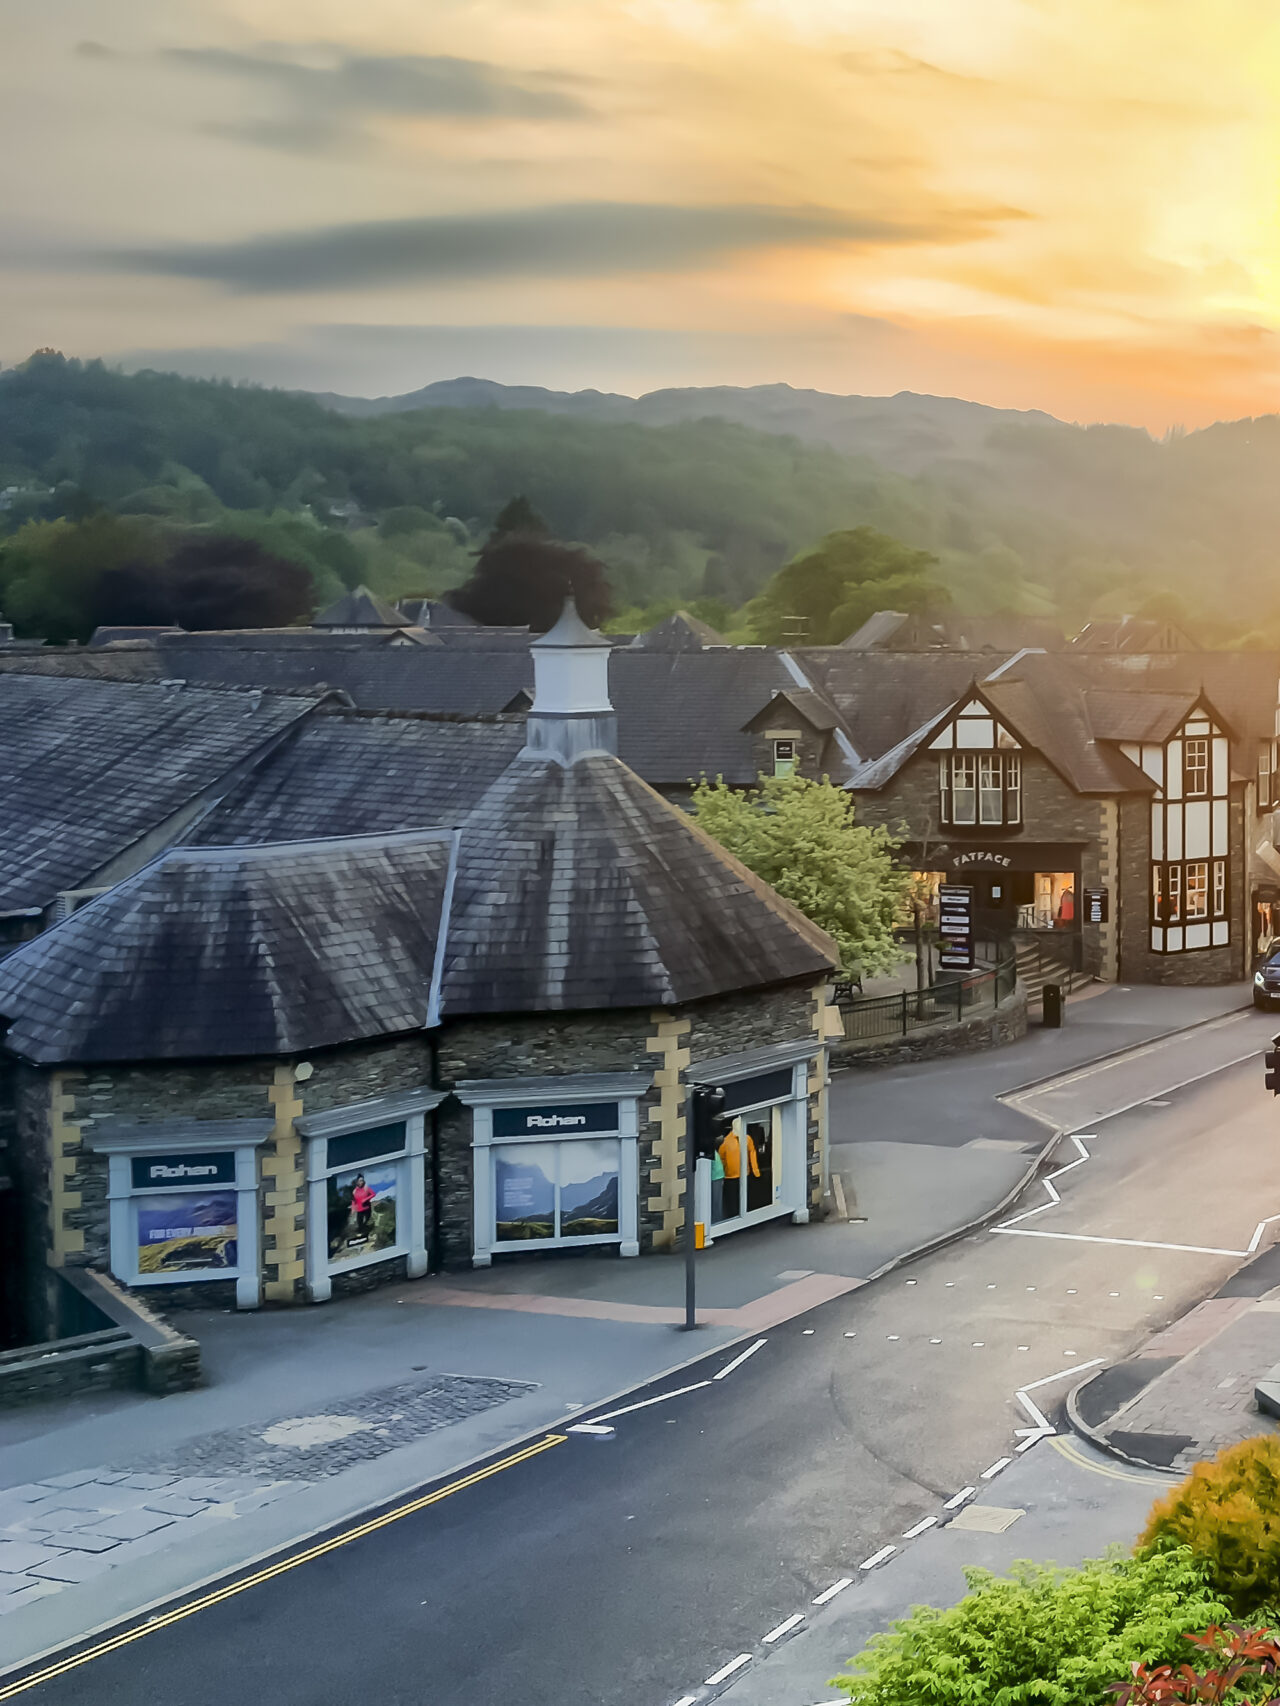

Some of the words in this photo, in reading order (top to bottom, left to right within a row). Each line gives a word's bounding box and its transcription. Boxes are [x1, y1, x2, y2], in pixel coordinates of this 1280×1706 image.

[952, 851, 1011, 867] FATFACE
[527, 1115, 586, 1127] Rohan
[150, 1164, 218, 1178] Rohan
